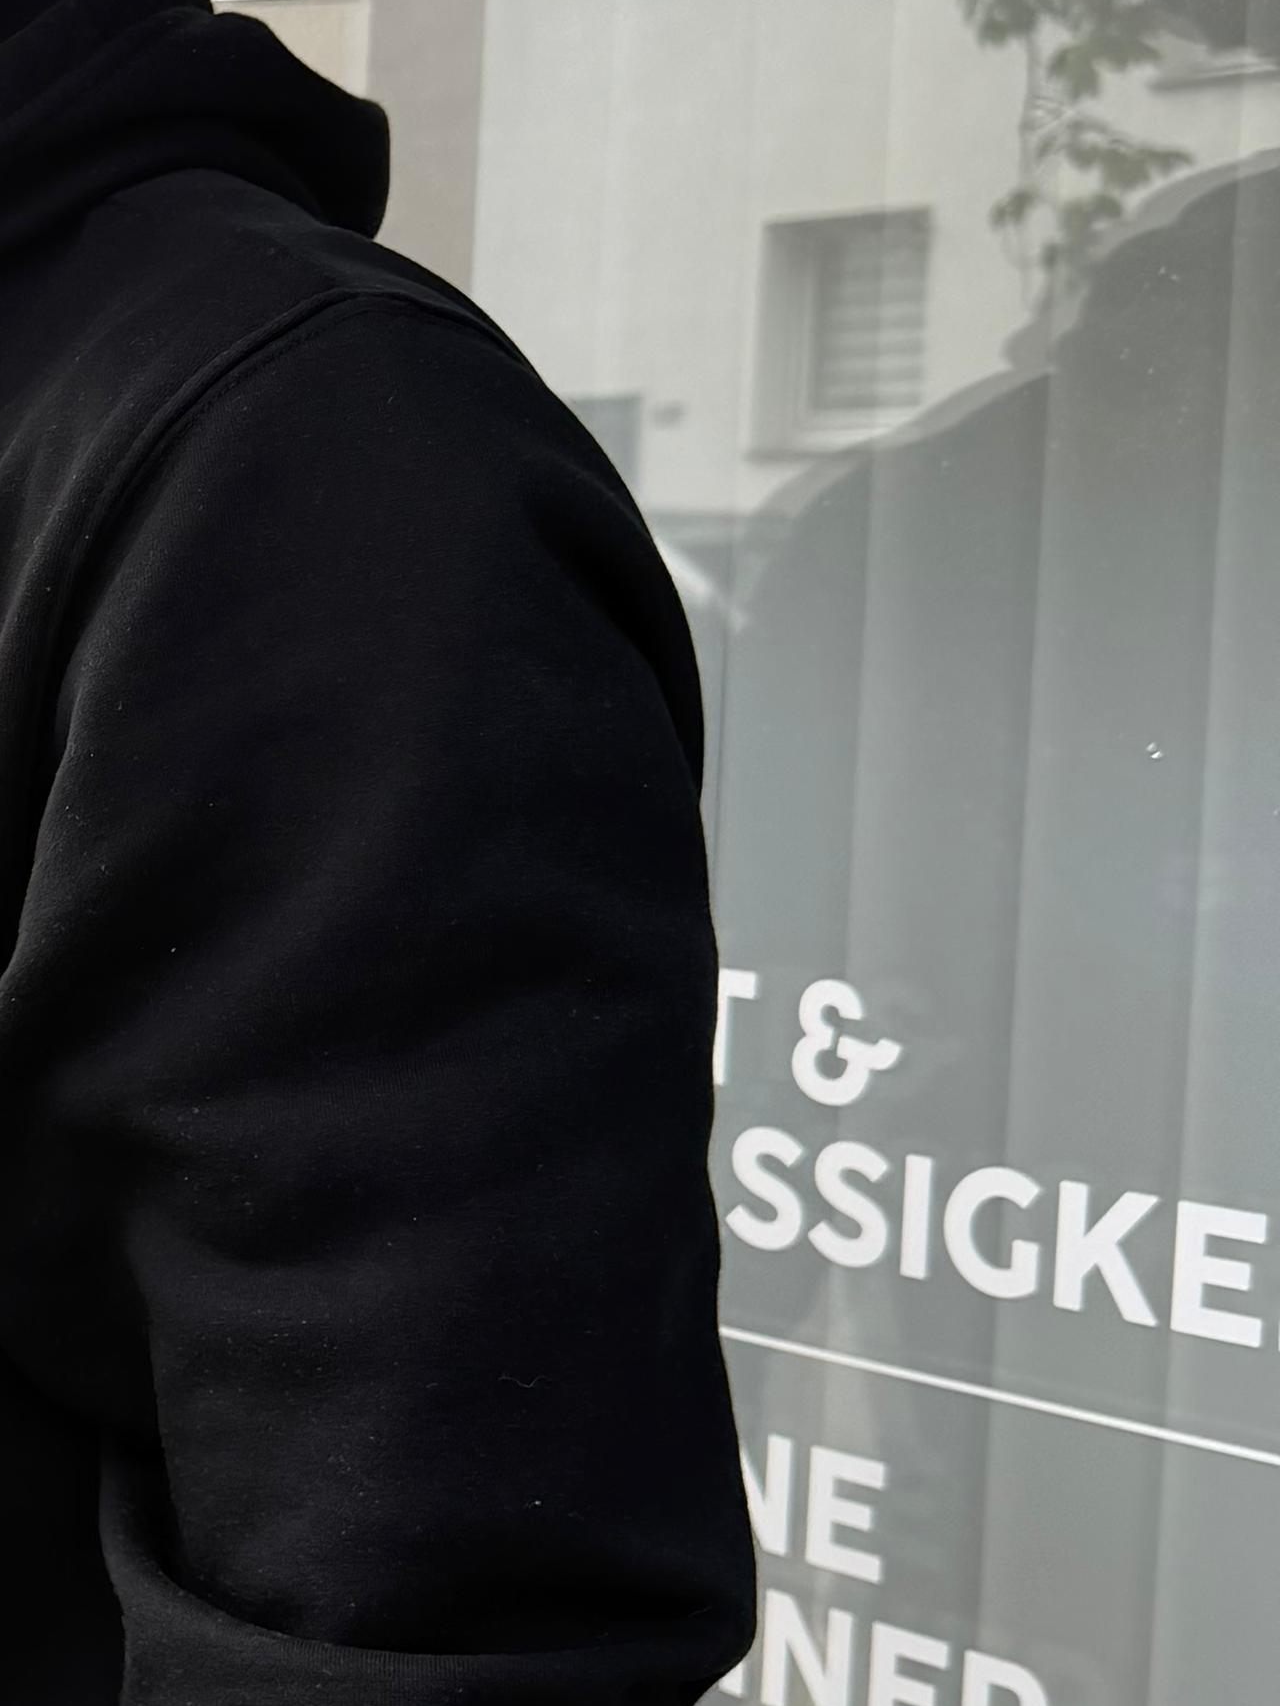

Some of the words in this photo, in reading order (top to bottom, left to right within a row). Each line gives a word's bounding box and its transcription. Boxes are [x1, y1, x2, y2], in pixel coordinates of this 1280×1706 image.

[791, 978, 903, 1107] &
[725, 1126, 1280, 1358] SSIGKE
[741, 1434, 886, 1583] NE
